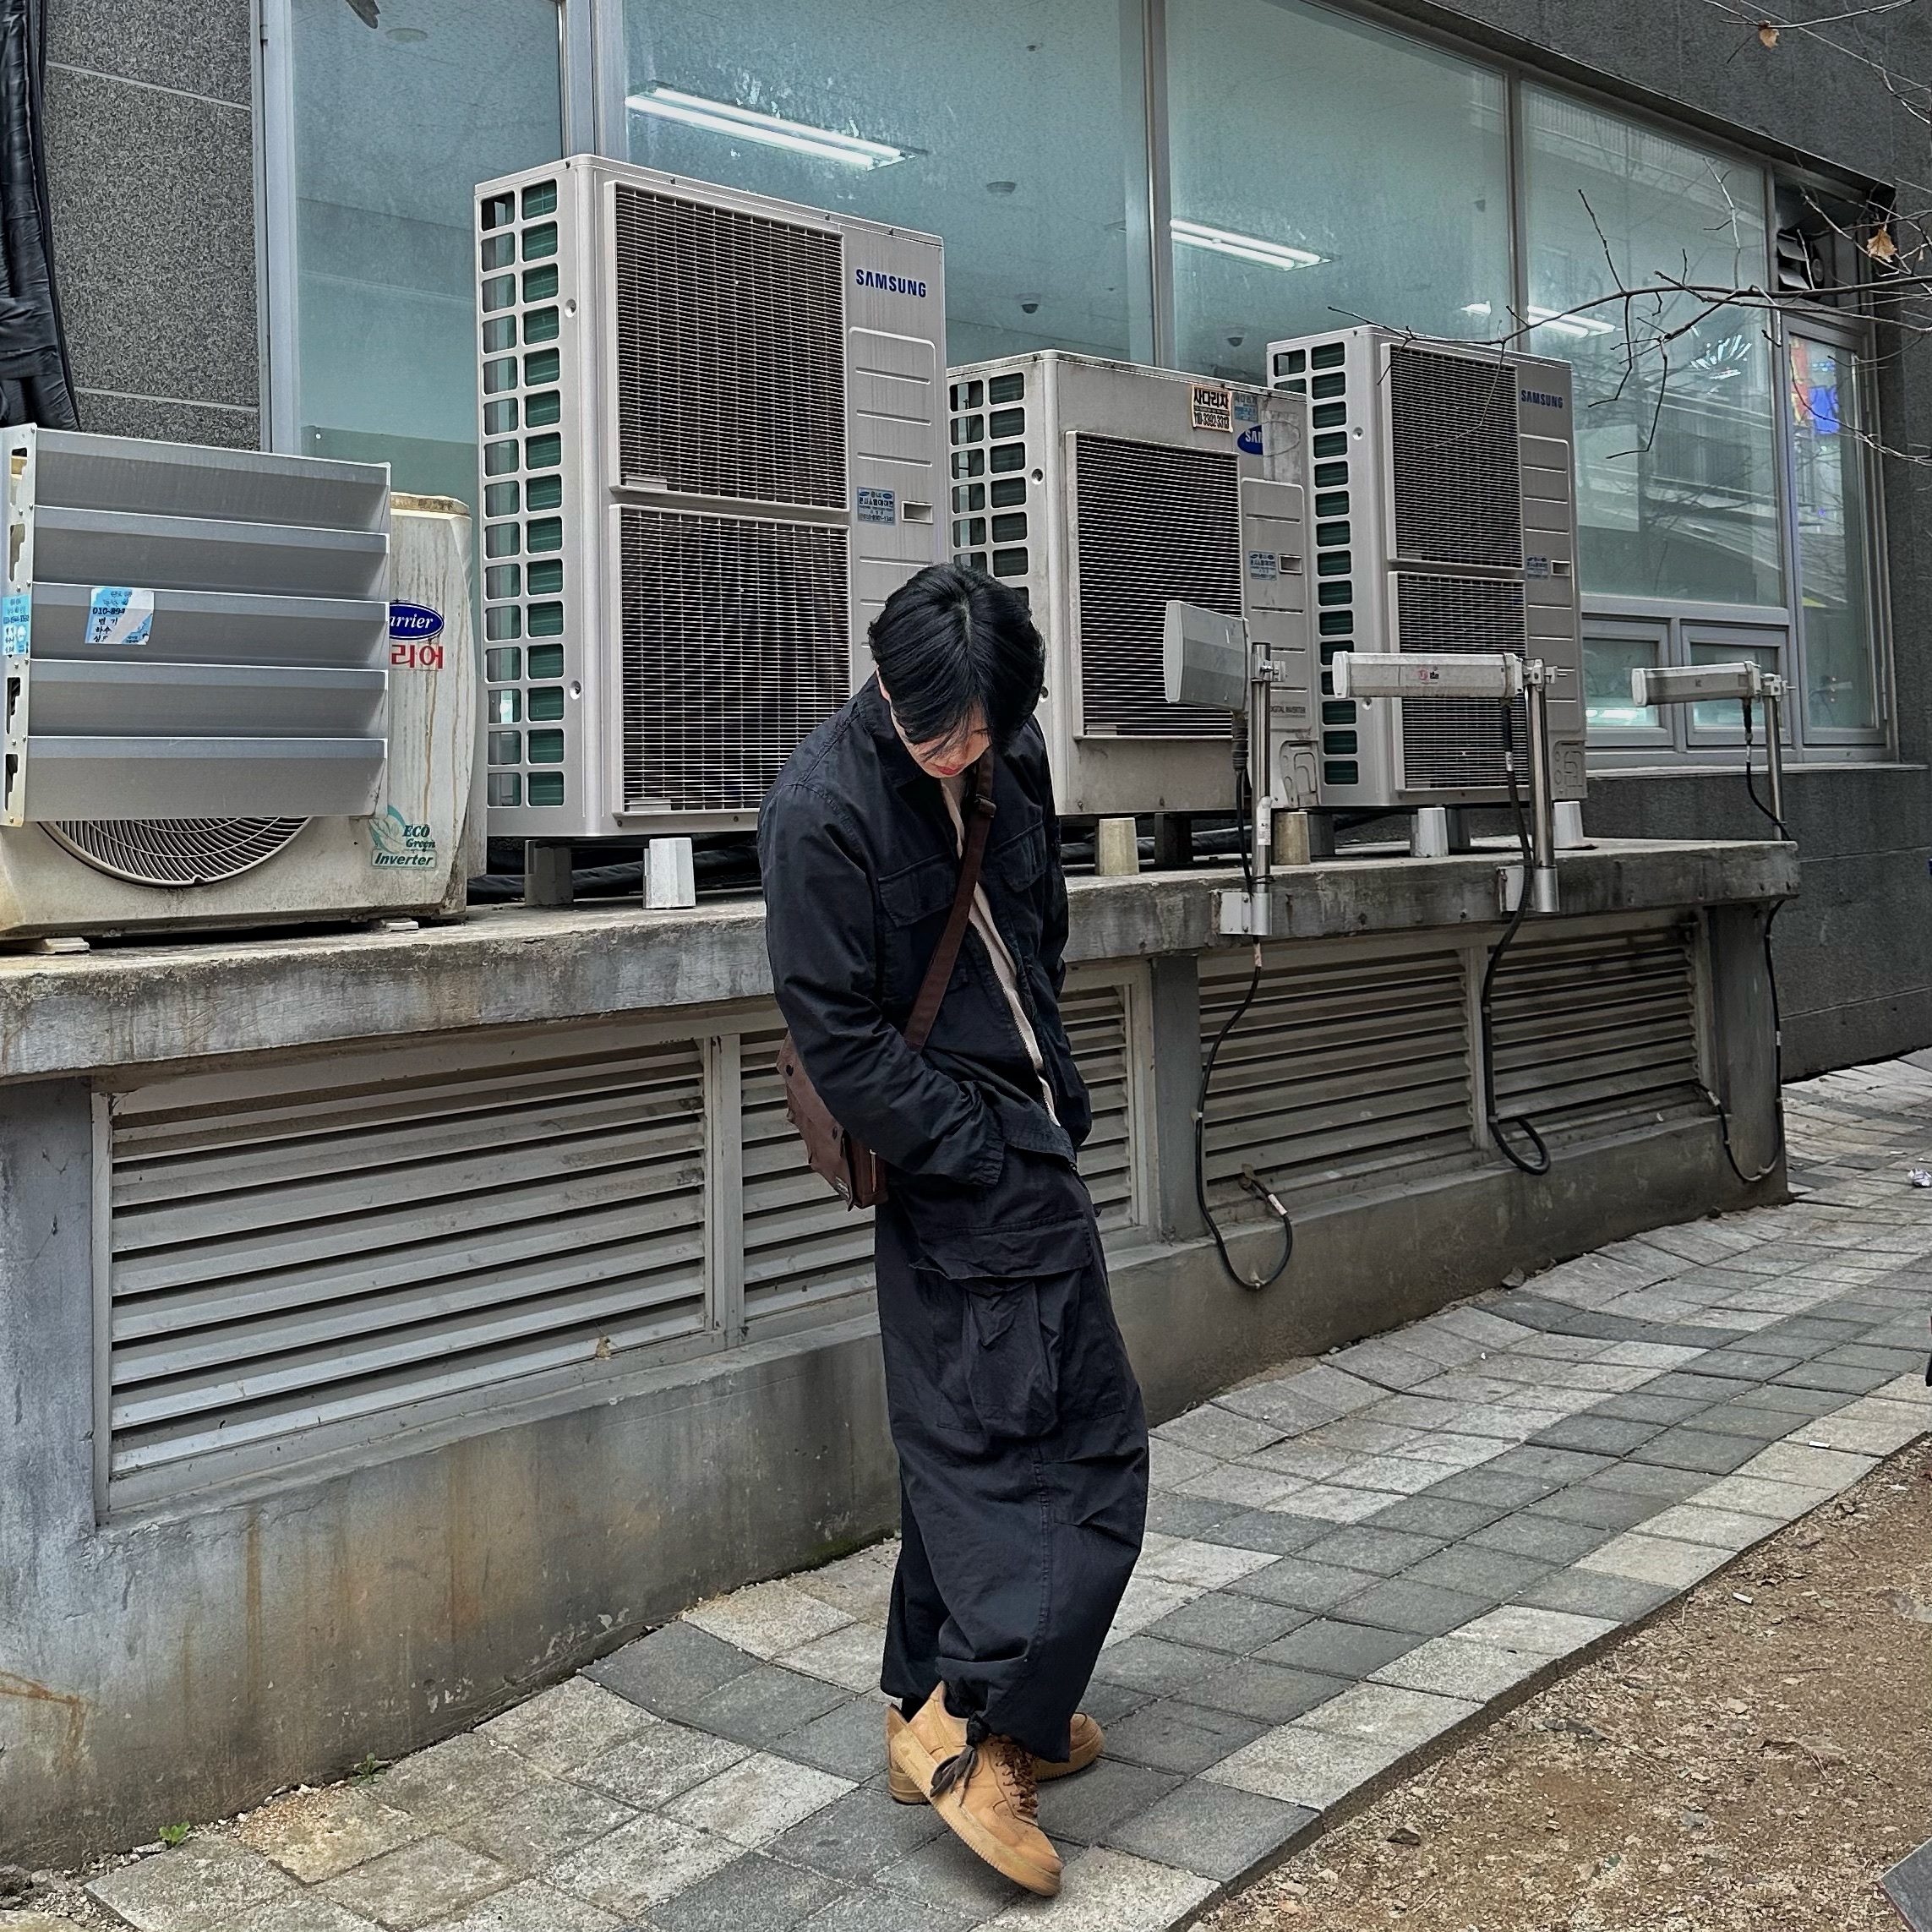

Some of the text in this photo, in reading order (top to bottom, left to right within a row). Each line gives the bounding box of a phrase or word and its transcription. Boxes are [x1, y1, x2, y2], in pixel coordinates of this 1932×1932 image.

[855, 269, 926, 298] SAMSUNG
[1521, 390, 1564, 409] SAMSUNG
[402, 825, 430, 838] ECO
[406, 838, 435, 848] Green
[374, 853, 434, 865] Inverter
